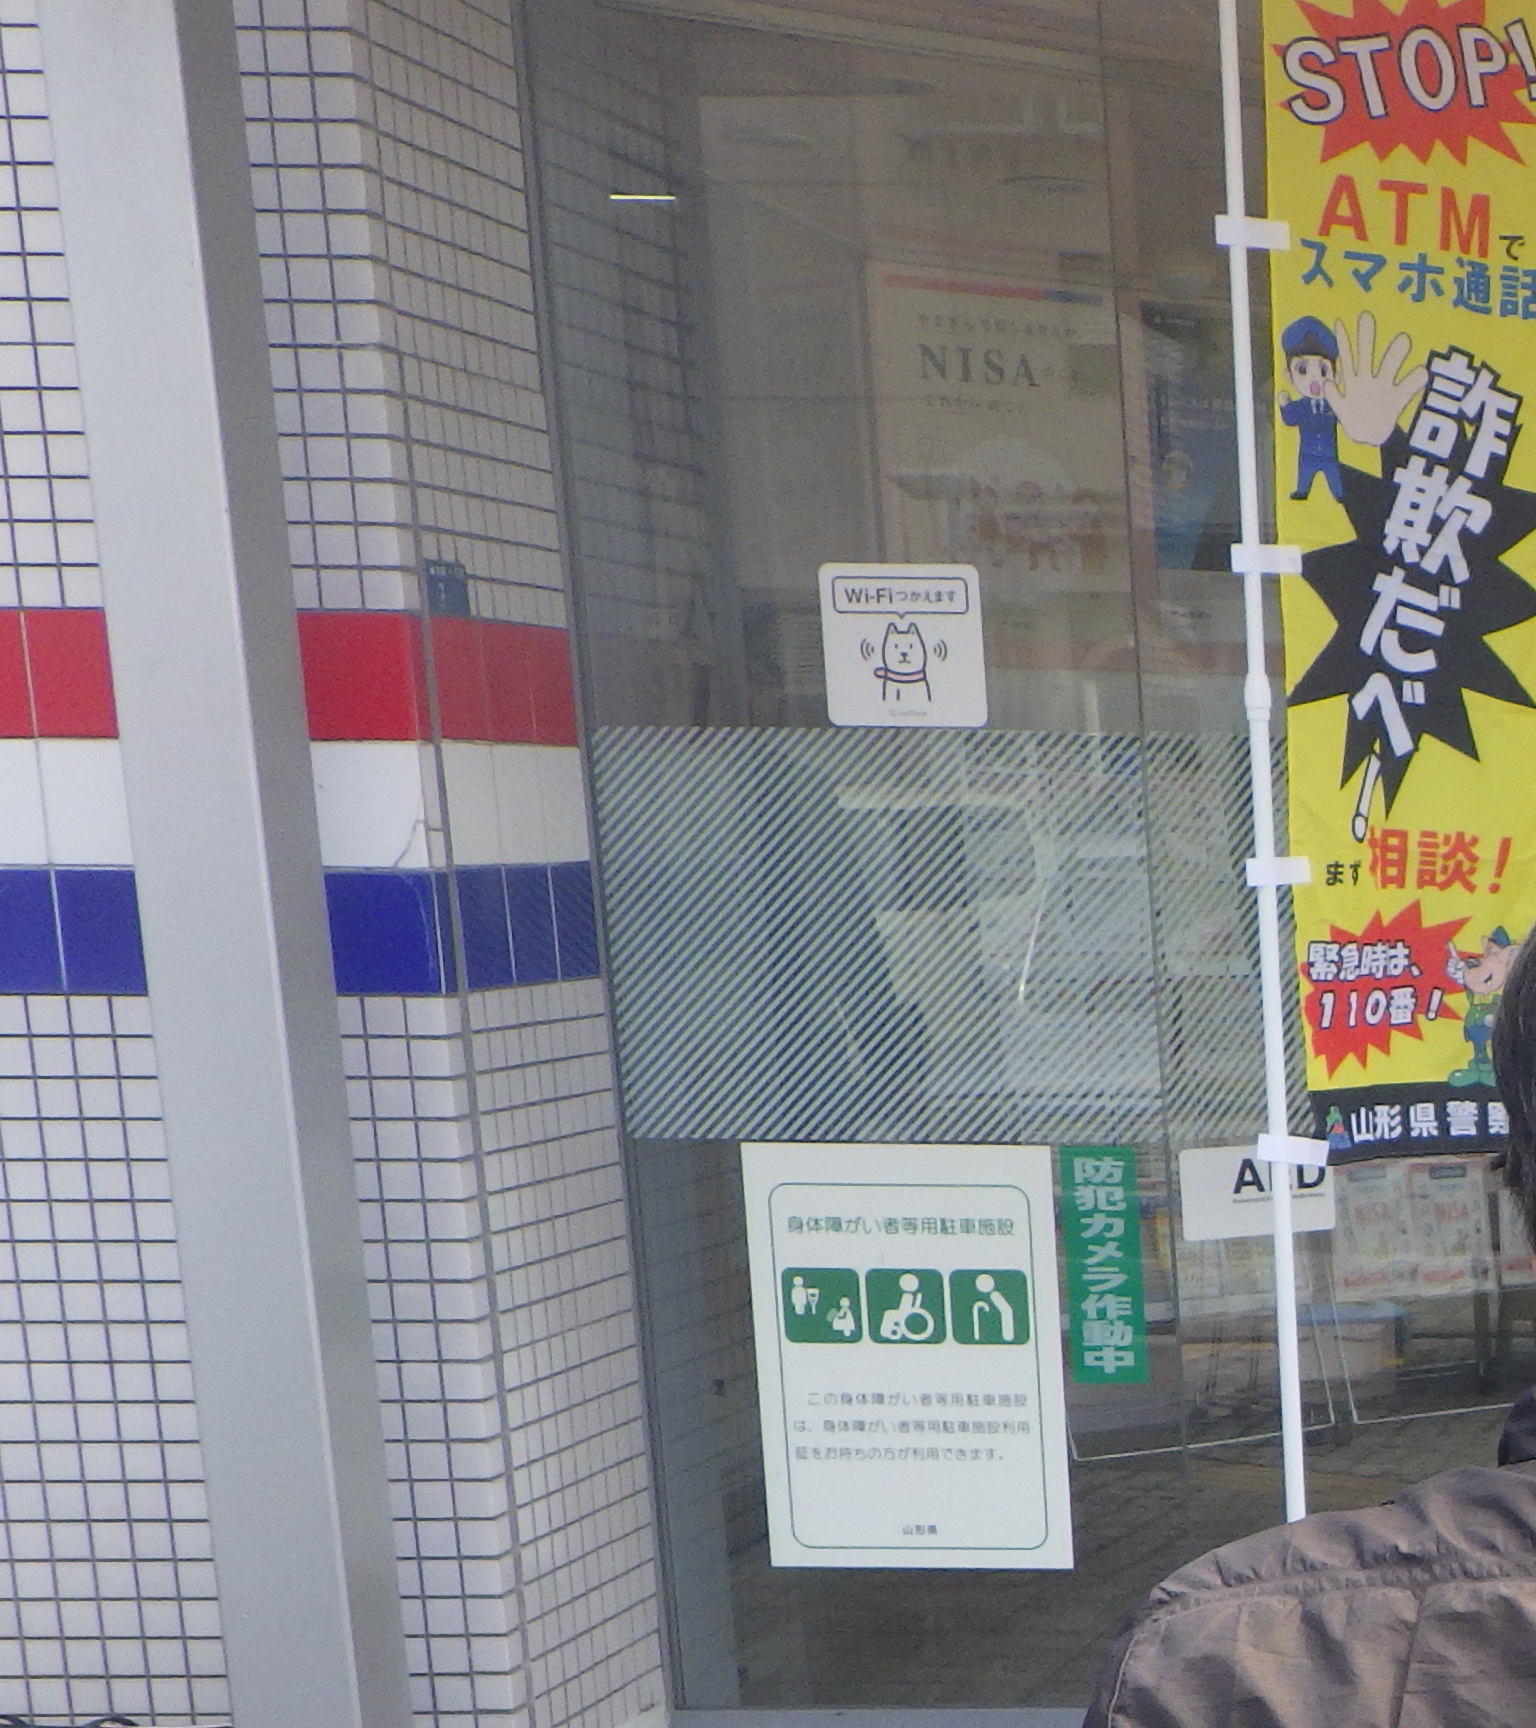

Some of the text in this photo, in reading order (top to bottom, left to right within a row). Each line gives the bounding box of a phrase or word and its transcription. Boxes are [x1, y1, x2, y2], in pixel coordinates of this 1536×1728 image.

[917, 343, 1040, 388] NISA
[844, 587, 958, 604] Wi-Fiつかえます
[1308, 940, 1423, 983] 緊急時は、
[1319, 987, 1445, 1029] 110番！
[1233, 1158, 1326, 1194] AD
[787, 1216, 1015, 1236] 身体障がい者等用駐車施設
[1073, 1156, 1135, 1375] 防犯カメラ作動中
